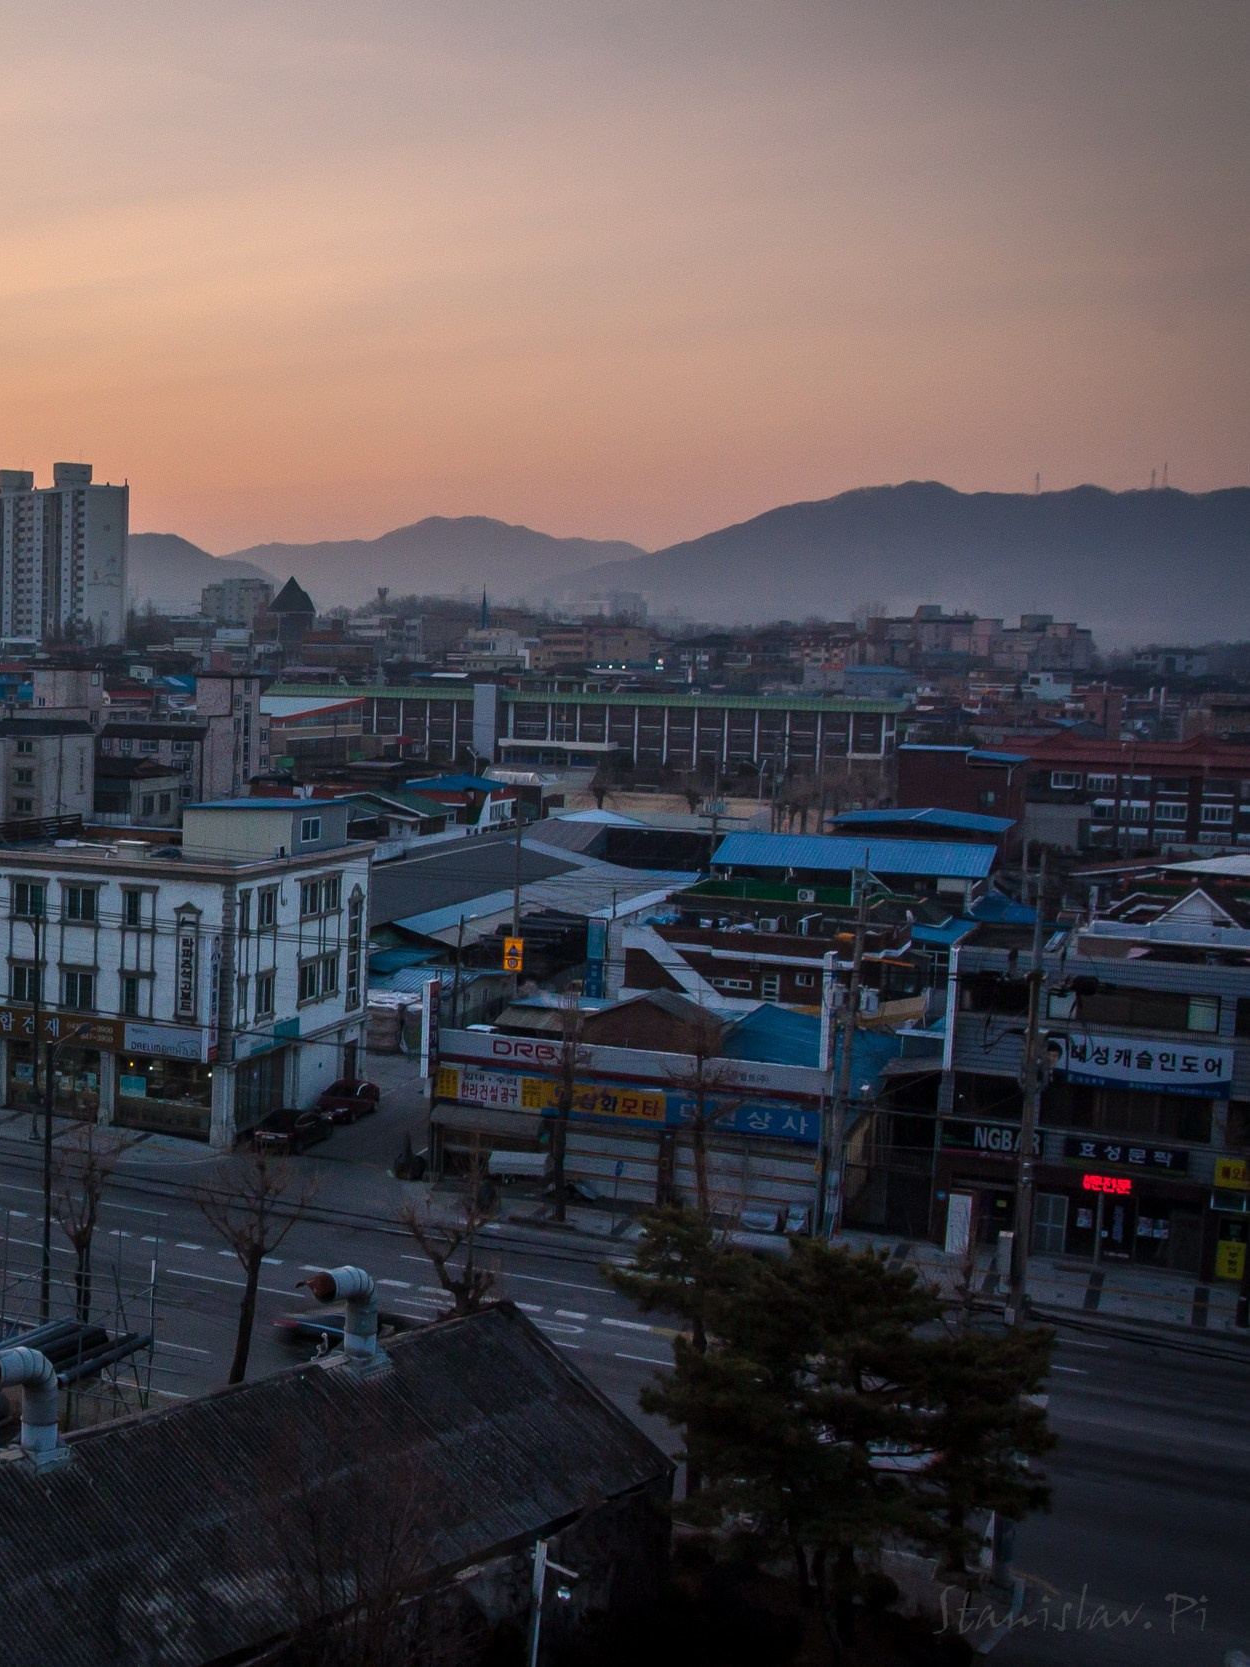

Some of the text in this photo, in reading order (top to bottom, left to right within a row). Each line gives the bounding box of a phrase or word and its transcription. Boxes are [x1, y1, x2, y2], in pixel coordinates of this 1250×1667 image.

[493, 1040, 555, 1060] DRB
[461, 1082, 518, 1104] 한라건설공구
[1078, 1142, 1173, 1167] 효성문짝
